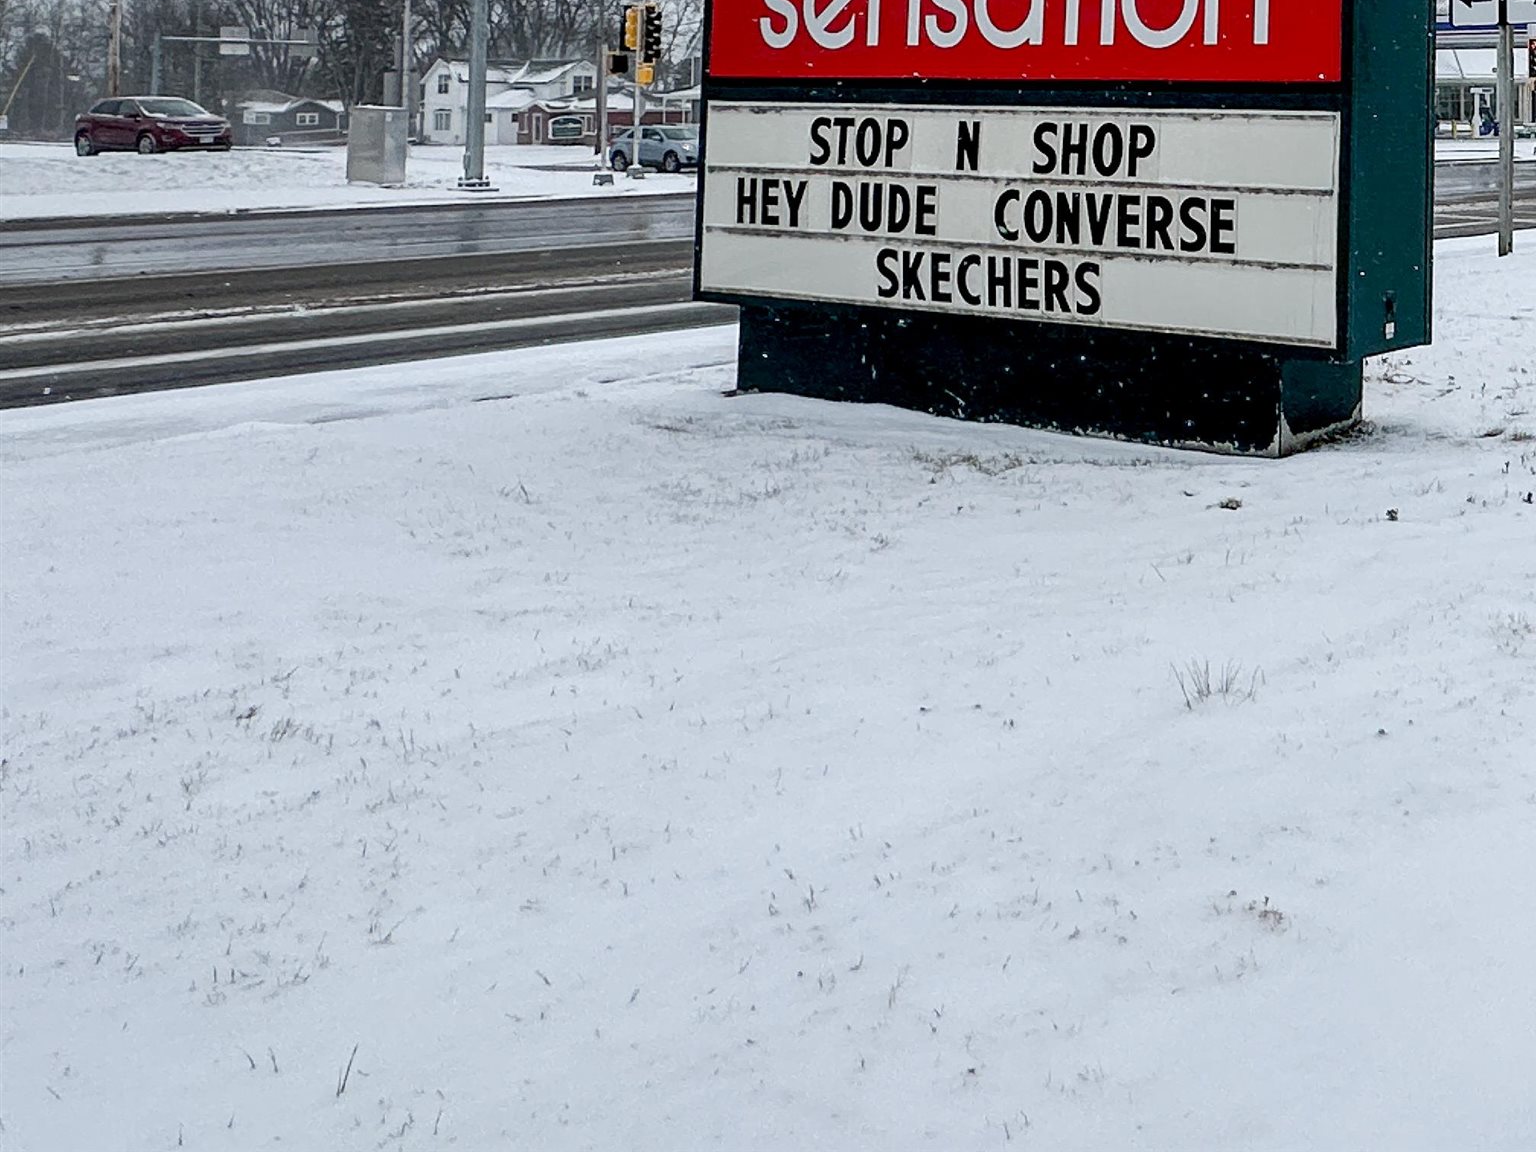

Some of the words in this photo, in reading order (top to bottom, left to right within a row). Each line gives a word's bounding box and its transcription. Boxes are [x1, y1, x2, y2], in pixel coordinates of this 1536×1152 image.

[810, 117, 909, 166] STOP
[956, 121, 980, 171] N
[1033, 123, 1156, 177] SHOP
[736, 178, 808, 228] HEY
[831, 185, 938, 236] DUDE
[994, 190, 1236, 253] CONVERSE
[877, 249, 1102, 315] SKECHERS
